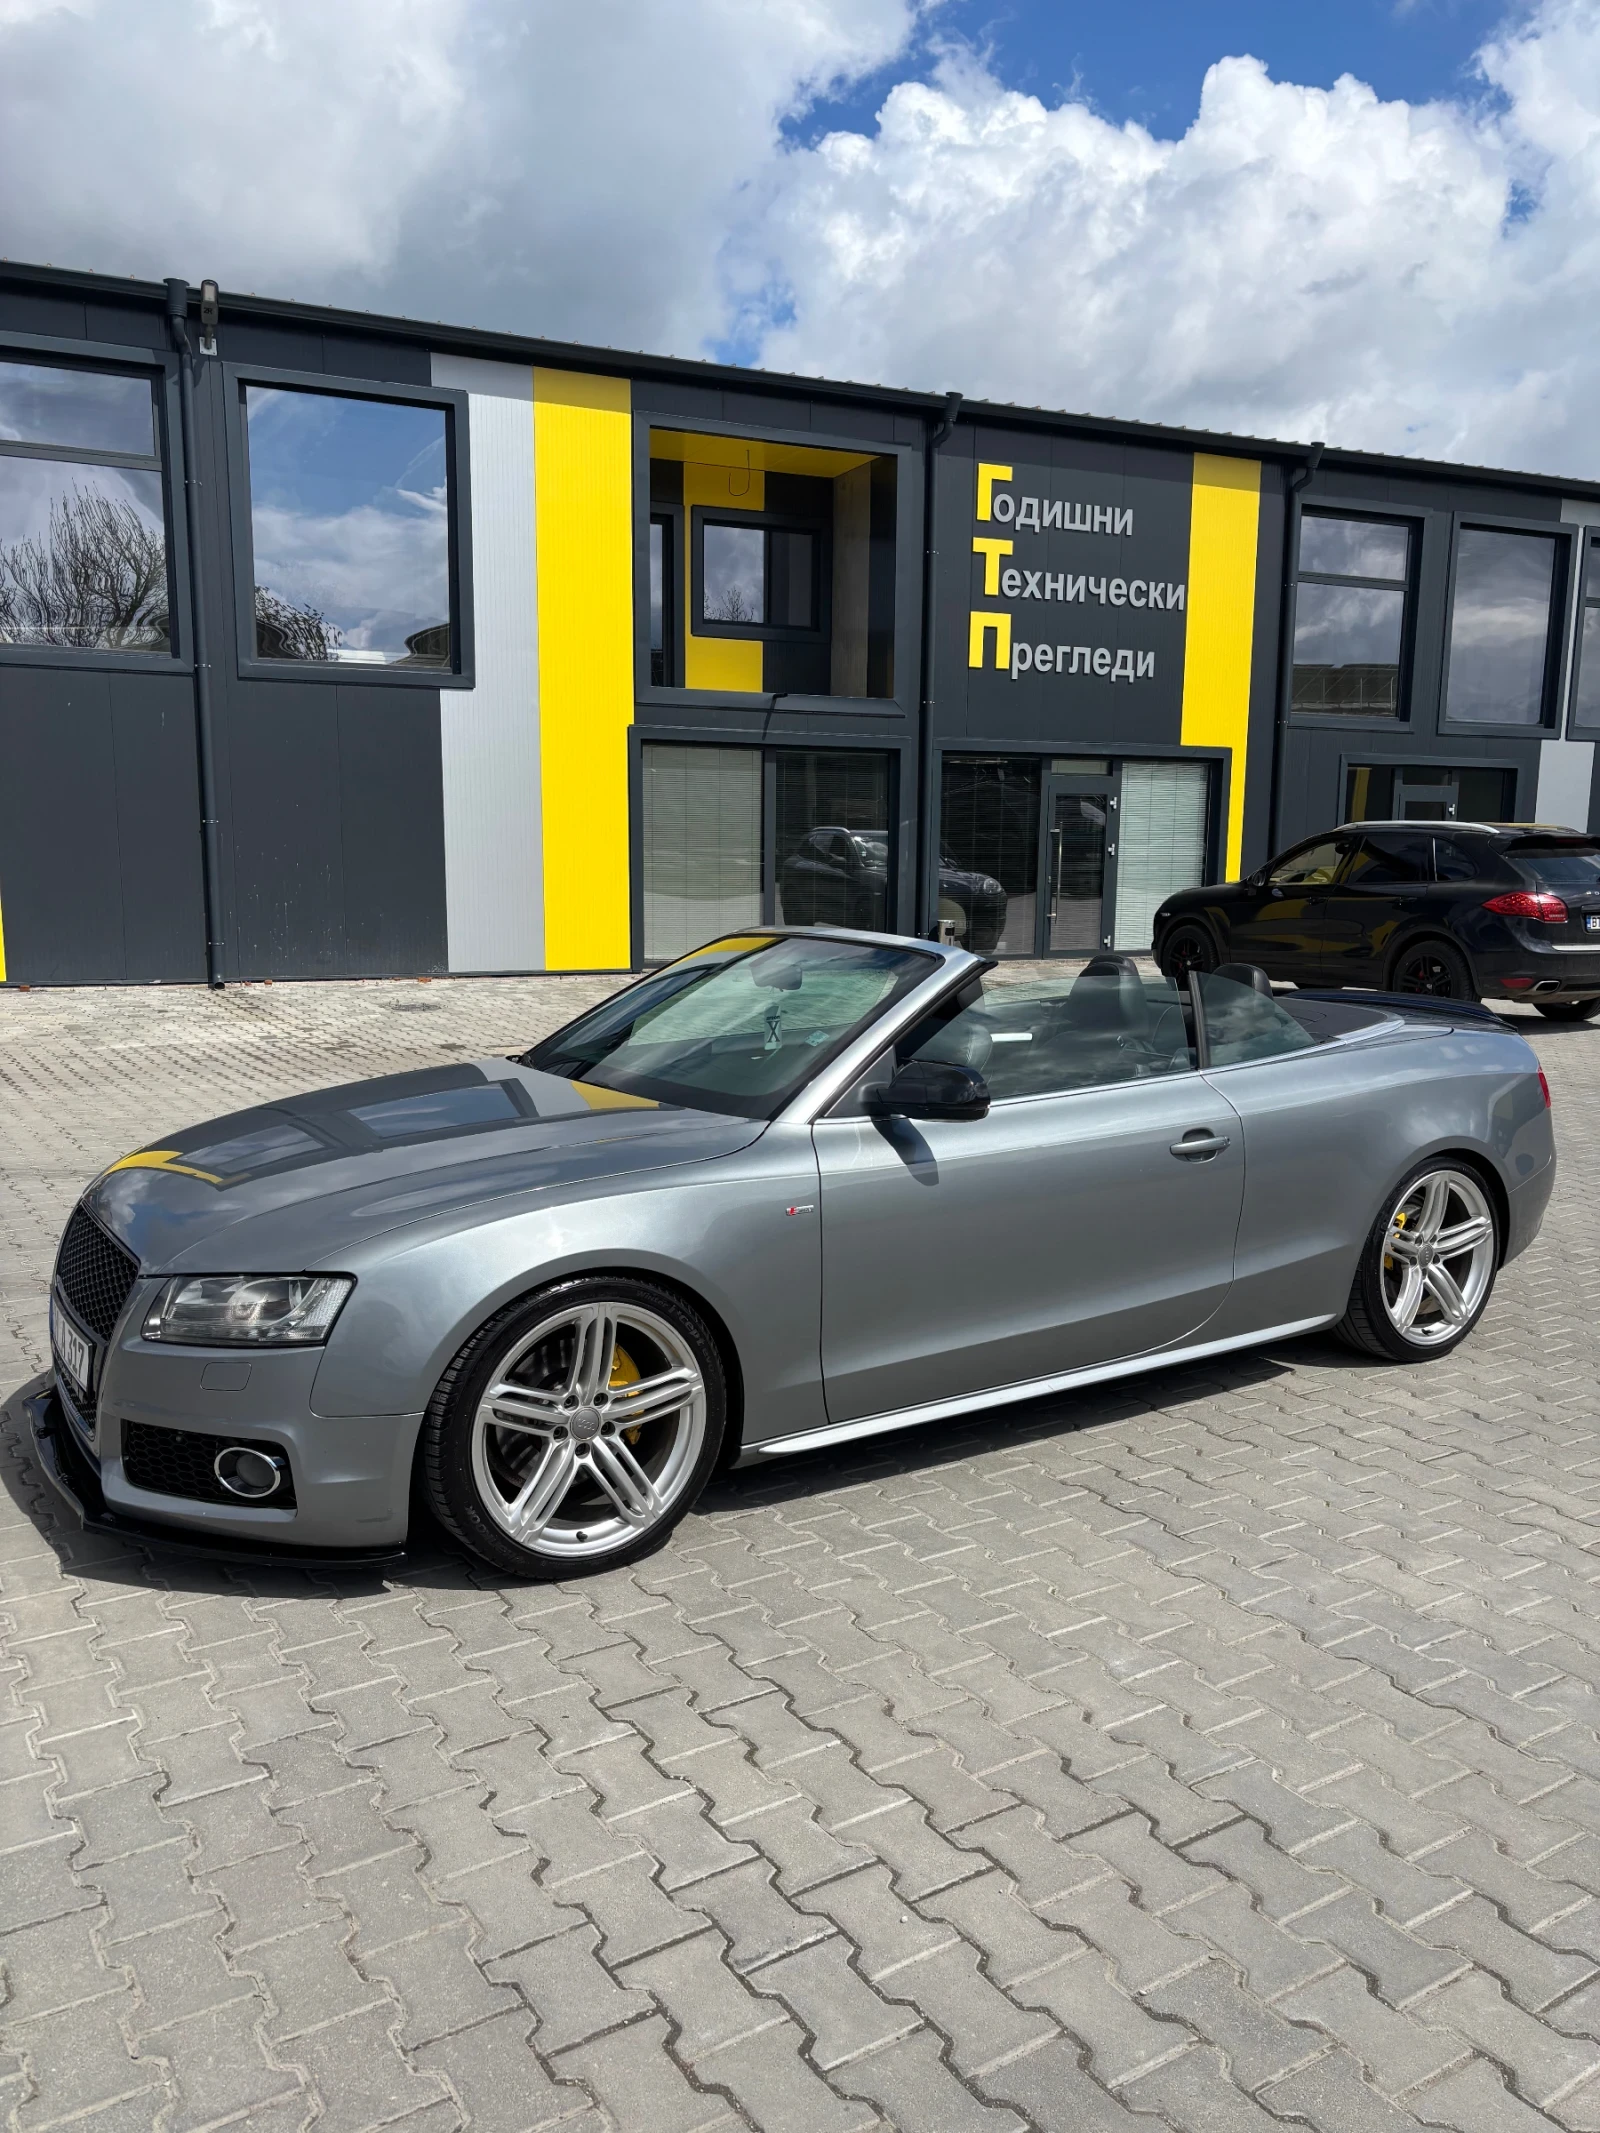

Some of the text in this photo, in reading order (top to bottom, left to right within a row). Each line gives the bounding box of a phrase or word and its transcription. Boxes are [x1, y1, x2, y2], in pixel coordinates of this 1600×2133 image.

[977, 463, 1133, 536] Годишни
[972, 537, 1185, 611] Технически
[968, 611, 1155, 683] Прегледи
[766, 1021, 780, 1042] X
[68, 1329, 84, 1379] 317
